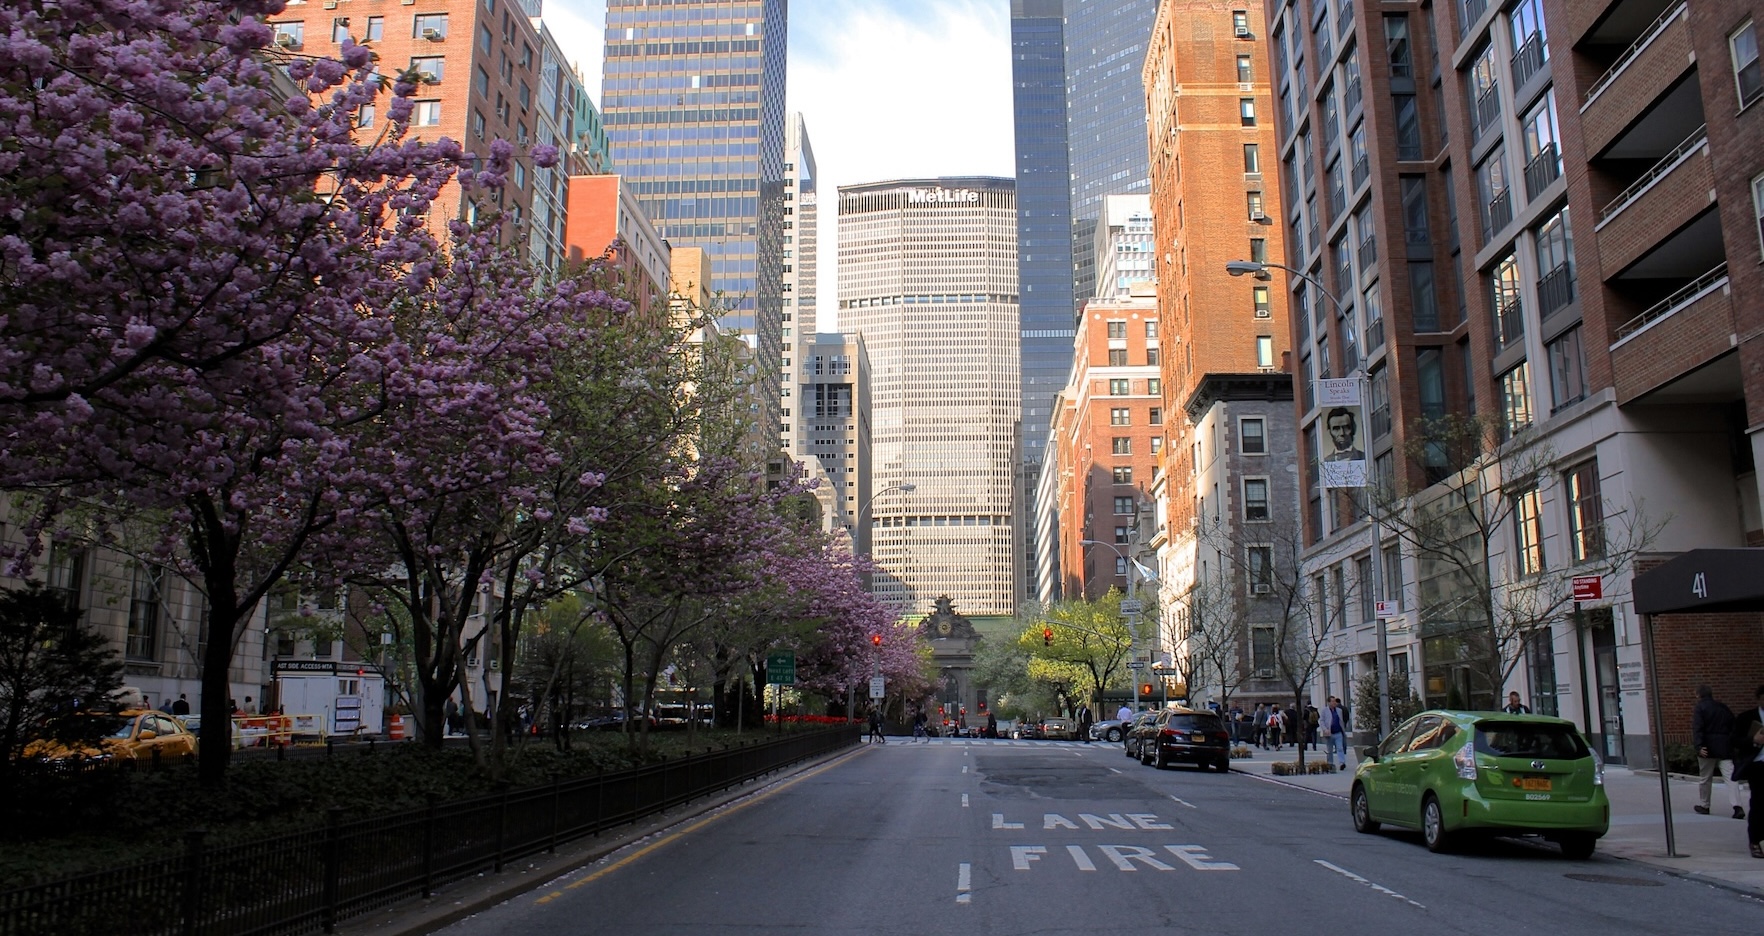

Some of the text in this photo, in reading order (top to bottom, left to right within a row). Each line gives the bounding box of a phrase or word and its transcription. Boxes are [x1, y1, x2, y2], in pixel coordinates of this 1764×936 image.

[908, 182, 979, 203] MetLife
[1324, 379, 1354, 389] Lincoln
[1329, 388, 1350, 396] Speaks
[1692, 572, 1707, 598] 41
[992, 813, 1175, 830] LANE
[1009, 844, 1241, 871] FIRE
